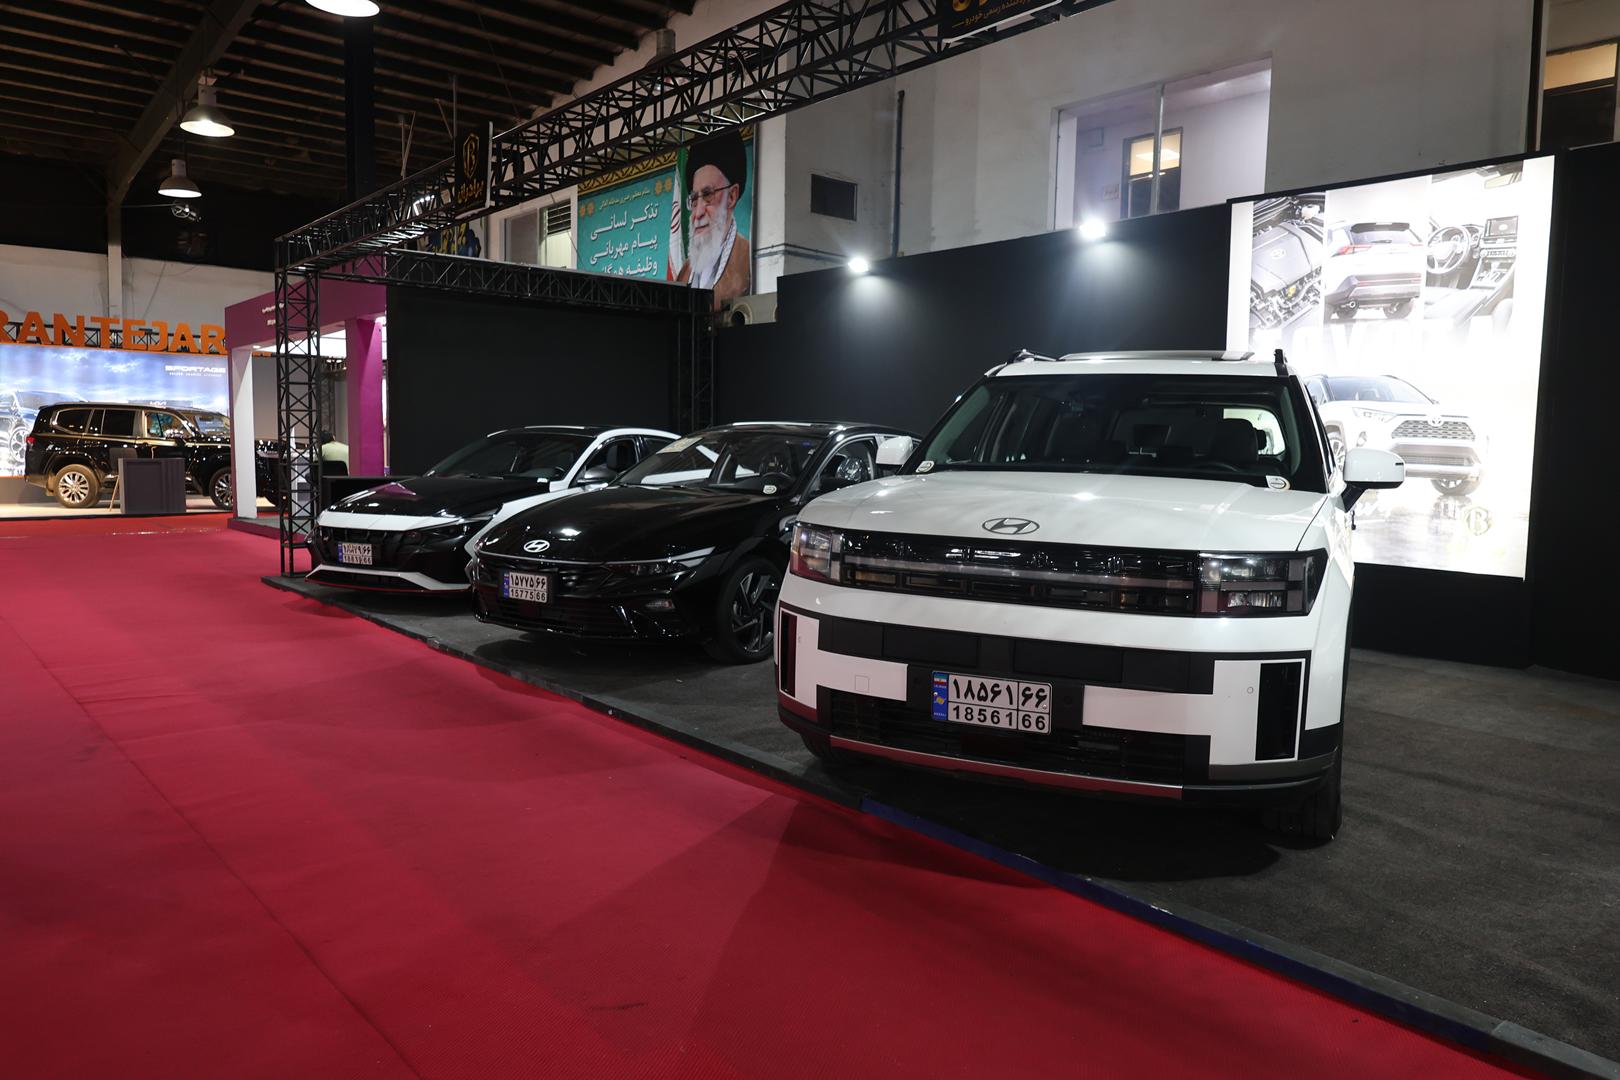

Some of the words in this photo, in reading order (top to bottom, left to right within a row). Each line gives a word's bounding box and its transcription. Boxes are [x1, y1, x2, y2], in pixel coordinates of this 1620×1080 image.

[590, 210, 628, 240] لسانی
[630, 203, 659, 230] تذکر
[590, 240, 629, 265] مهربانی
[631, 233, 658, 254] پیام
[626, 256, 658, 277] وظیفه
[510, 574, 535, 588] ۱۵۷۷۵
[535, 577, 546, 589] ۶۶
[511, 588, 534, 600] 15775
[536, 591, 546, 602] 66
[953, 678, 1014, 706] ۱۸۵۶۱
[1021, 686, 1048, 709] ۶۶
[953, 705, 1013, 727] 18561
[1021, 713, 1046, 731] 66
